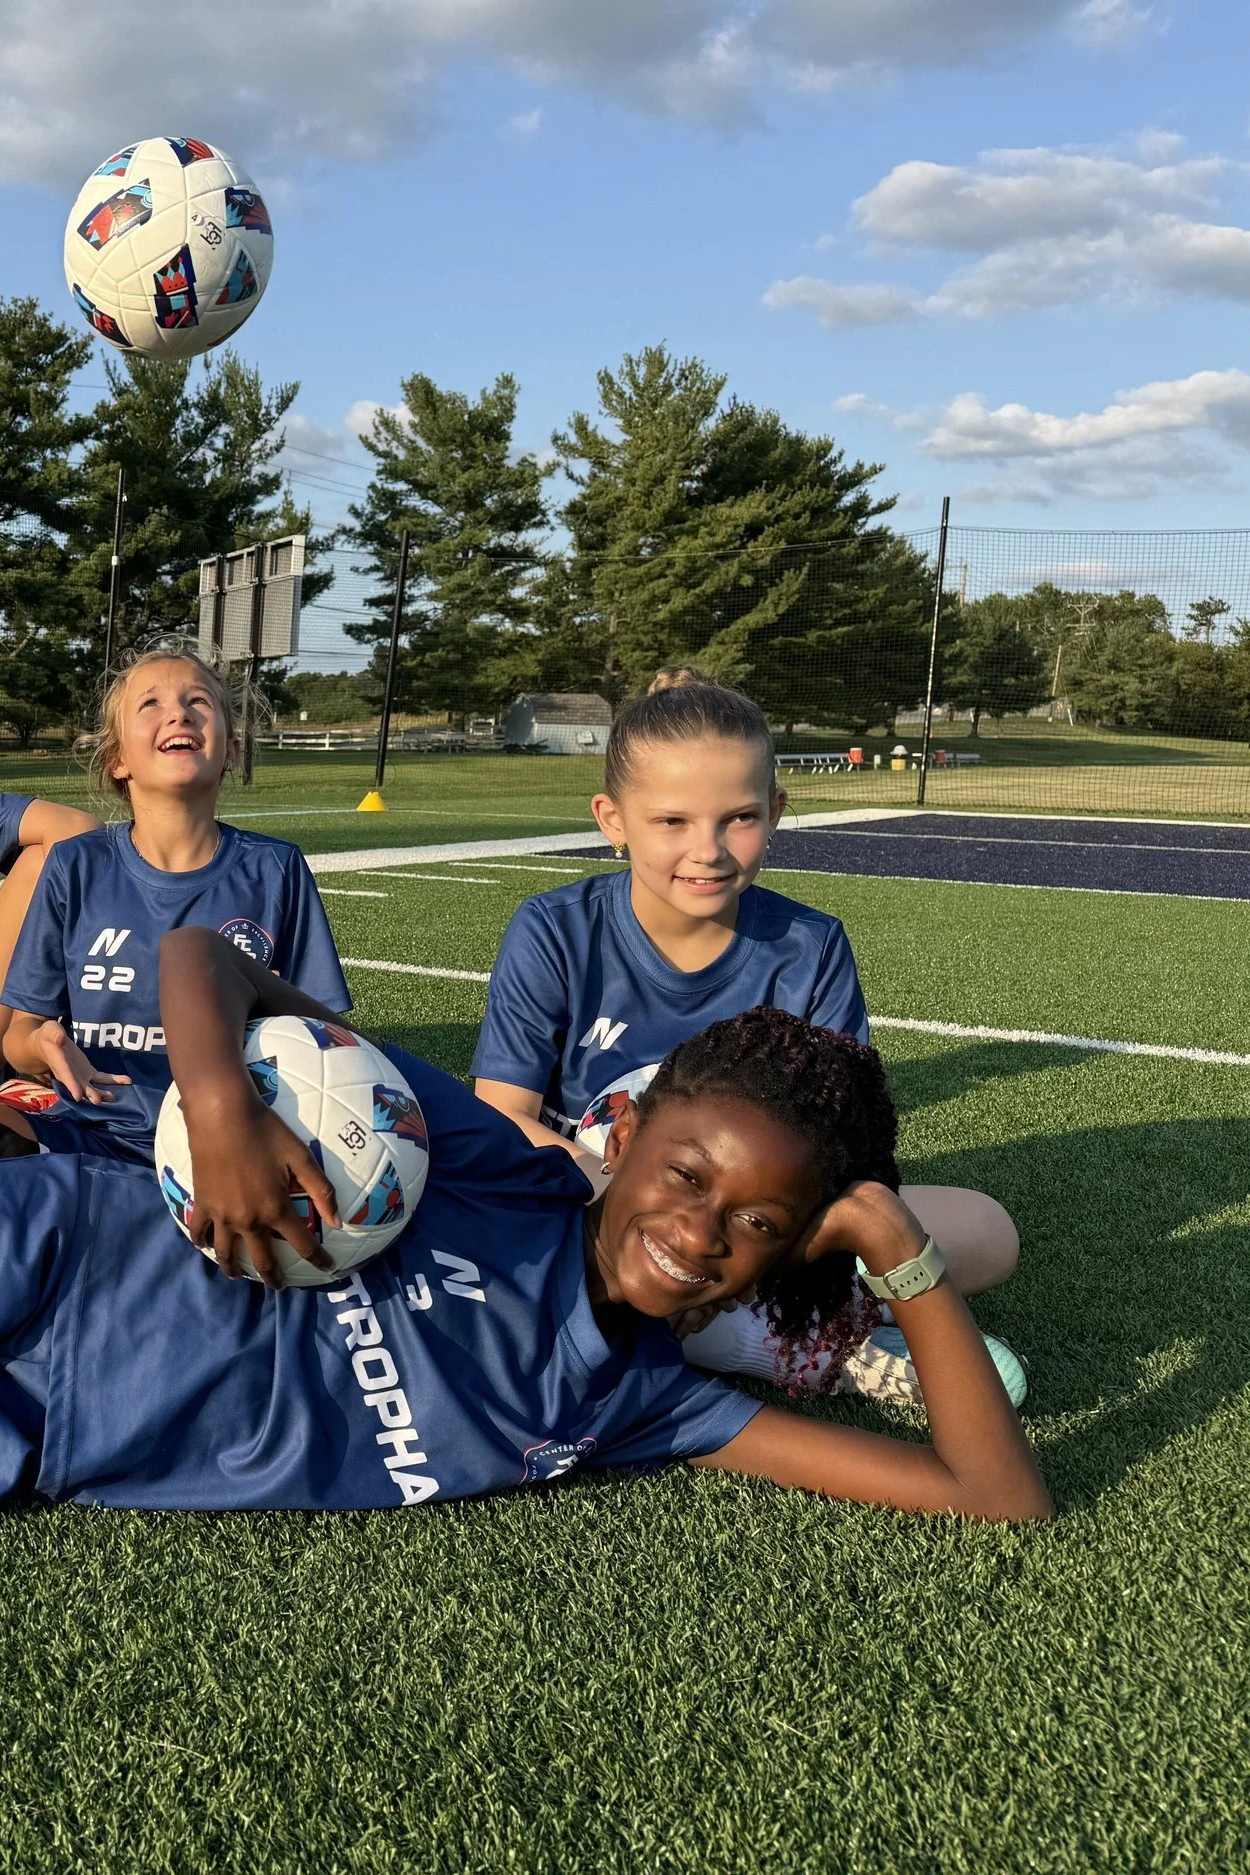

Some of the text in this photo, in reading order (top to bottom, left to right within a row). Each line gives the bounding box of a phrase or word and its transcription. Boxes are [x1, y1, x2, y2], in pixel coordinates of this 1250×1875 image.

[80, 964, 136, 993] 22
[327, 1272, 440, 1507] TROPHA
[538, 1444, 574, 1456] CENTER
